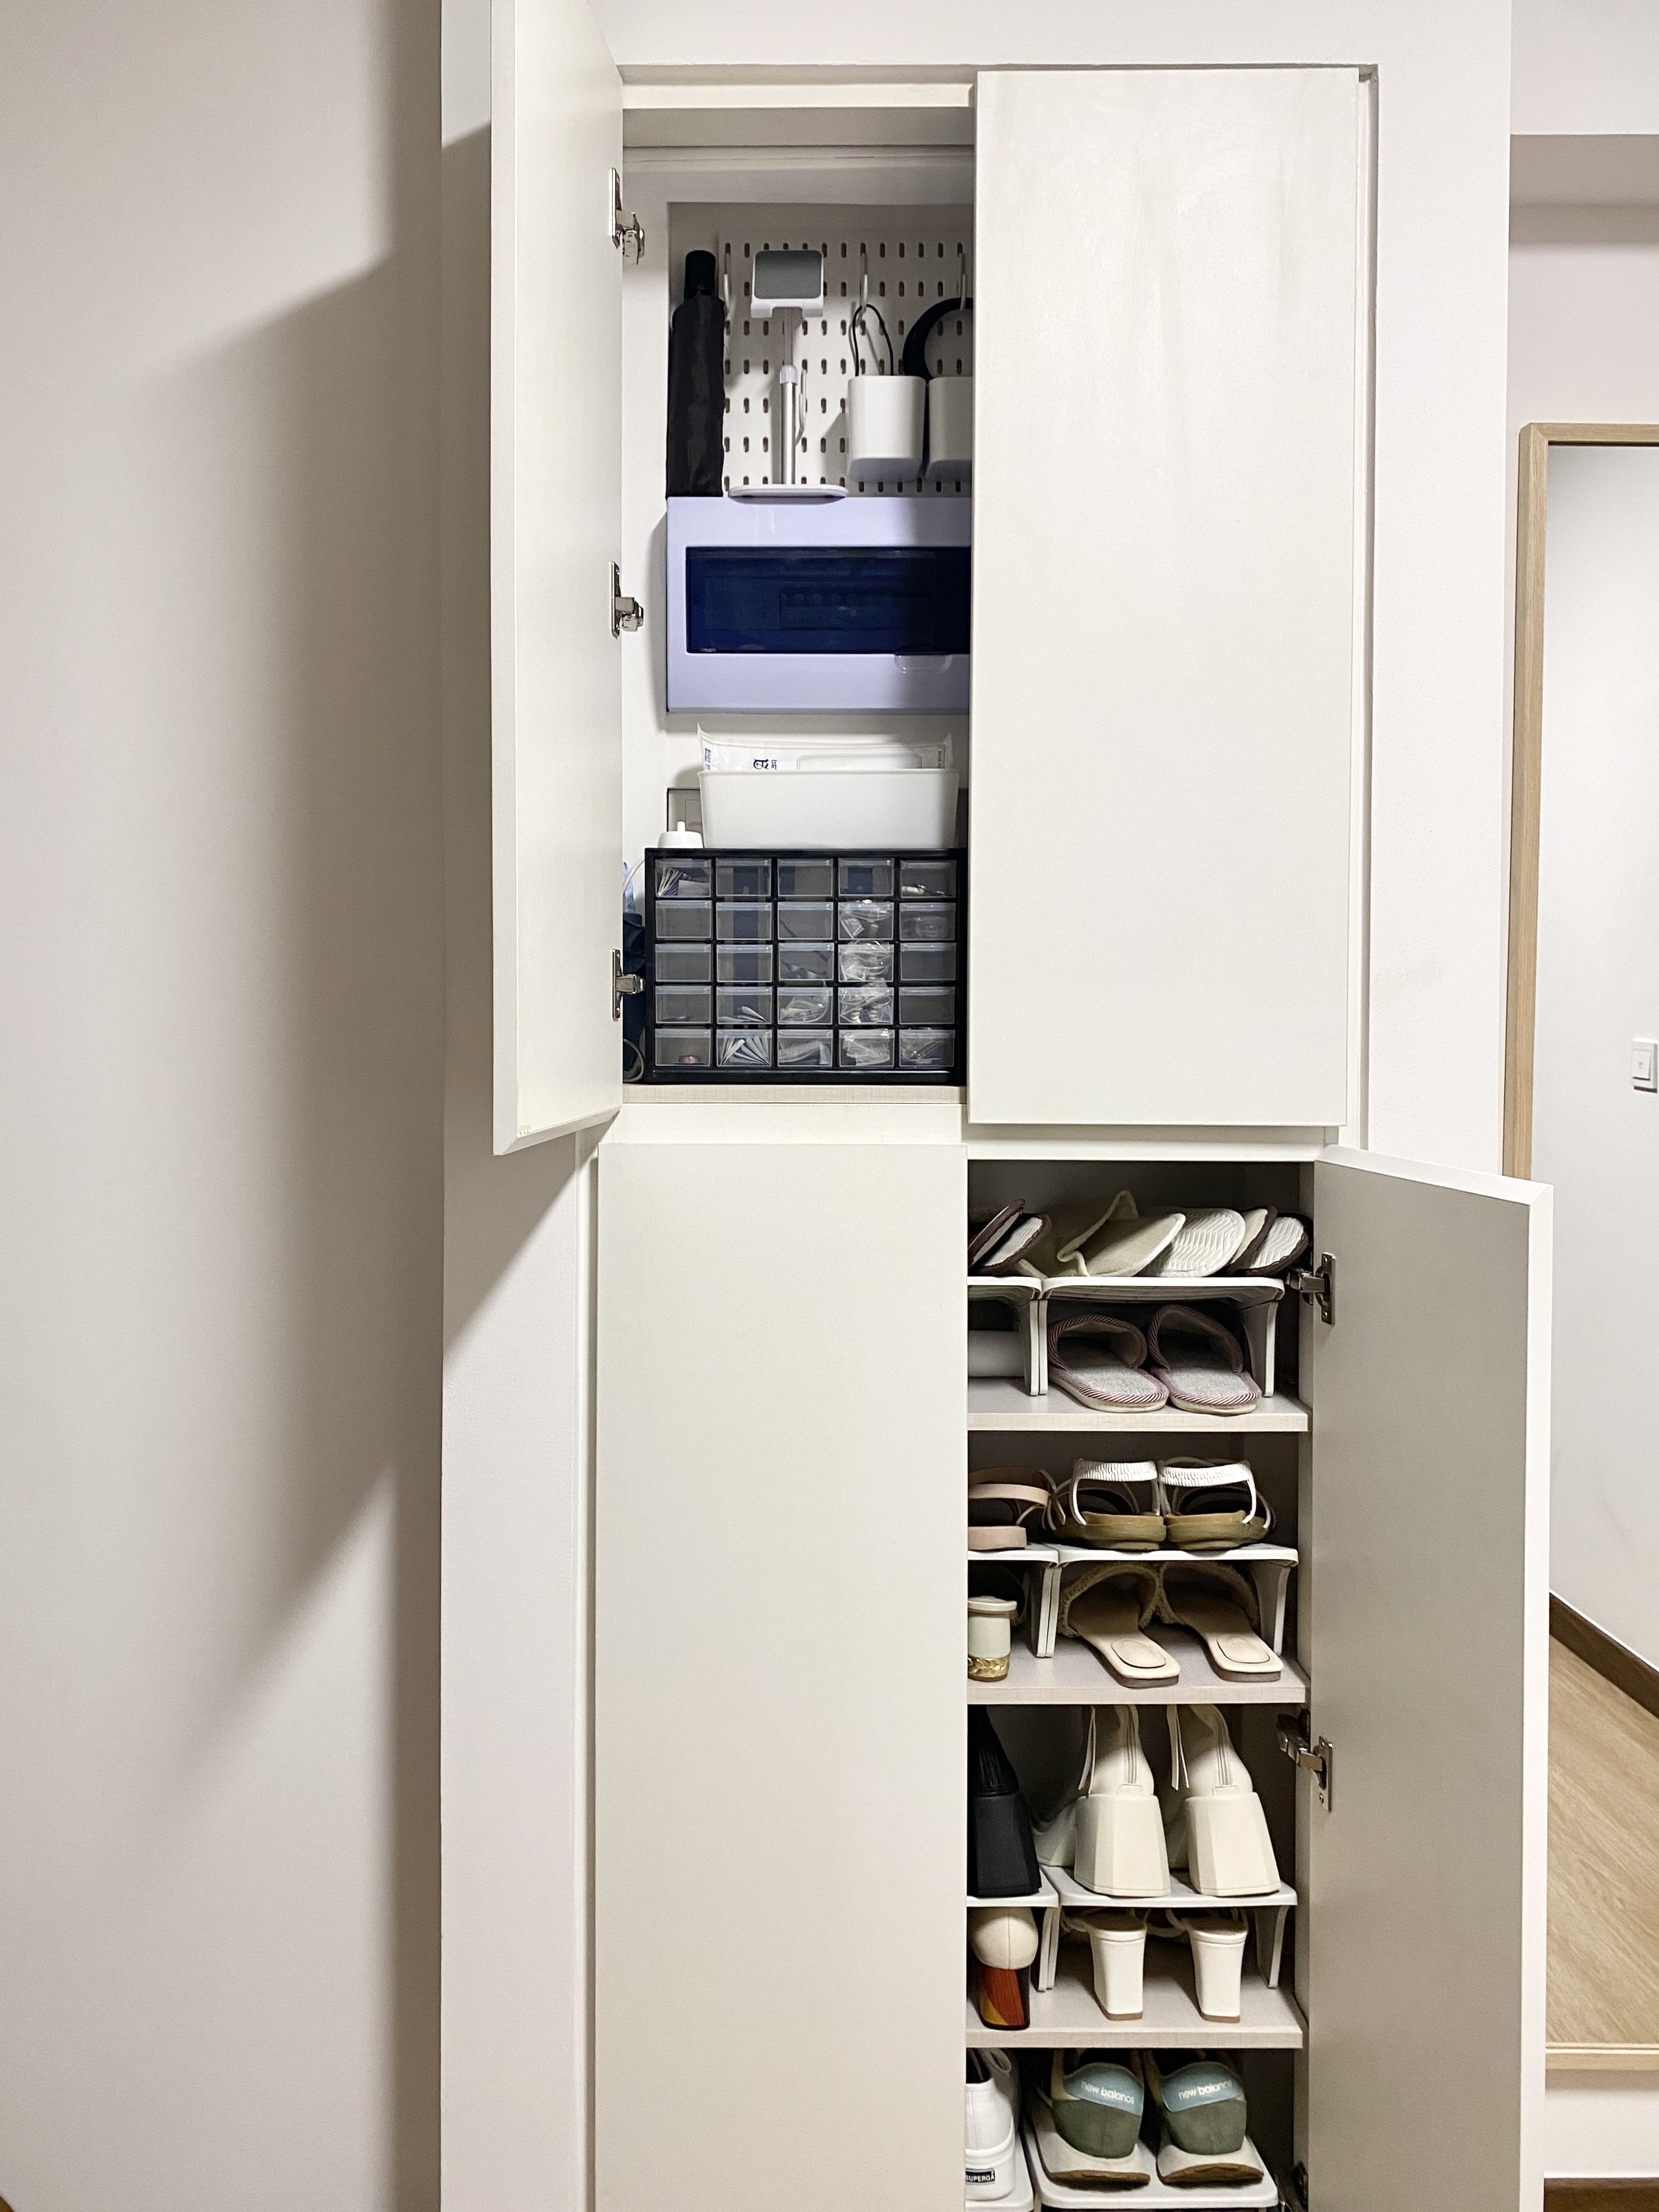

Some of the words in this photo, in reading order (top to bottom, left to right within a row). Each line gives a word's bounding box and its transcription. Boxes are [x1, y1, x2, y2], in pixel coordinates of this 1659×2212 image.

[1081, 2081, 1099, 2094] new
[1101, 2086, 1135, 2104] balance
[1178, 2089, 1197, 2100] new
[1197, 2080, 1232, 2095] balance
